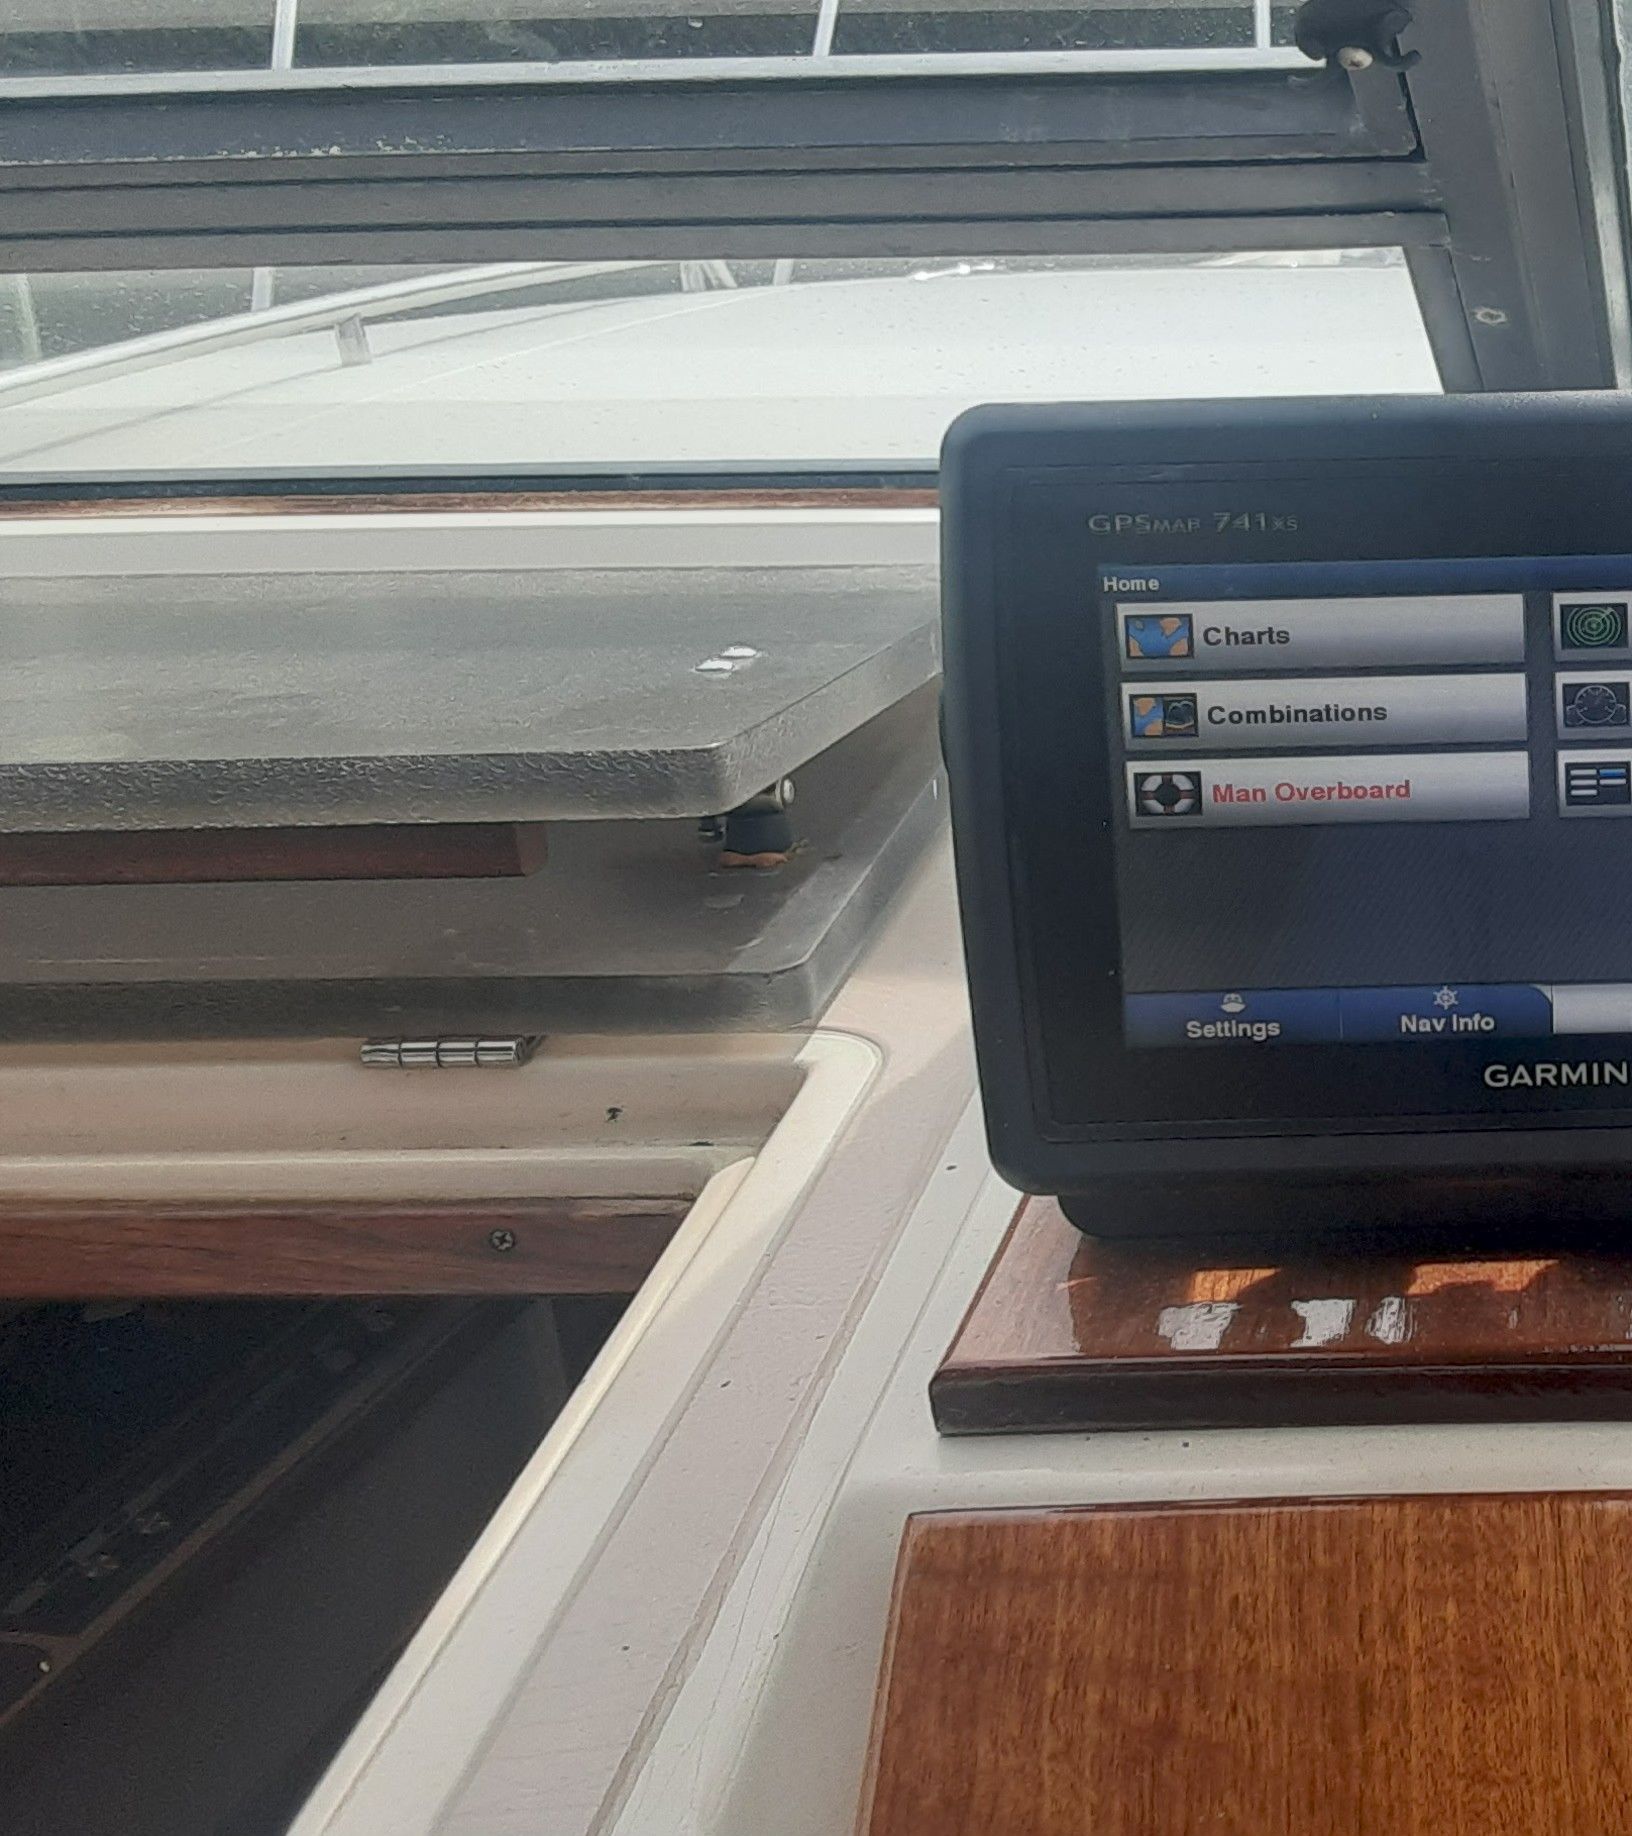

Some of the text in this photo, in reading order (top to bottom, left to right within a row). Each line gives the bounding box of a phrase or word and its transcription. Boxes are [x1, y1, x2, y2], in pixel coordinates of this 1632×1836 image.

[1103, 576, 1160, 592] Home
[1203, 626, 1290, 646] Charts
[1207, 704, 1388, 726] Combinations
[1212, 780, 1411, 803] Man Overboard
[1186, 1020, 1281, 1041] Settings
[1401, 1013, 1495, 1032] Nav Info
[1484, 1061, 1629, 1087] GARMIN
